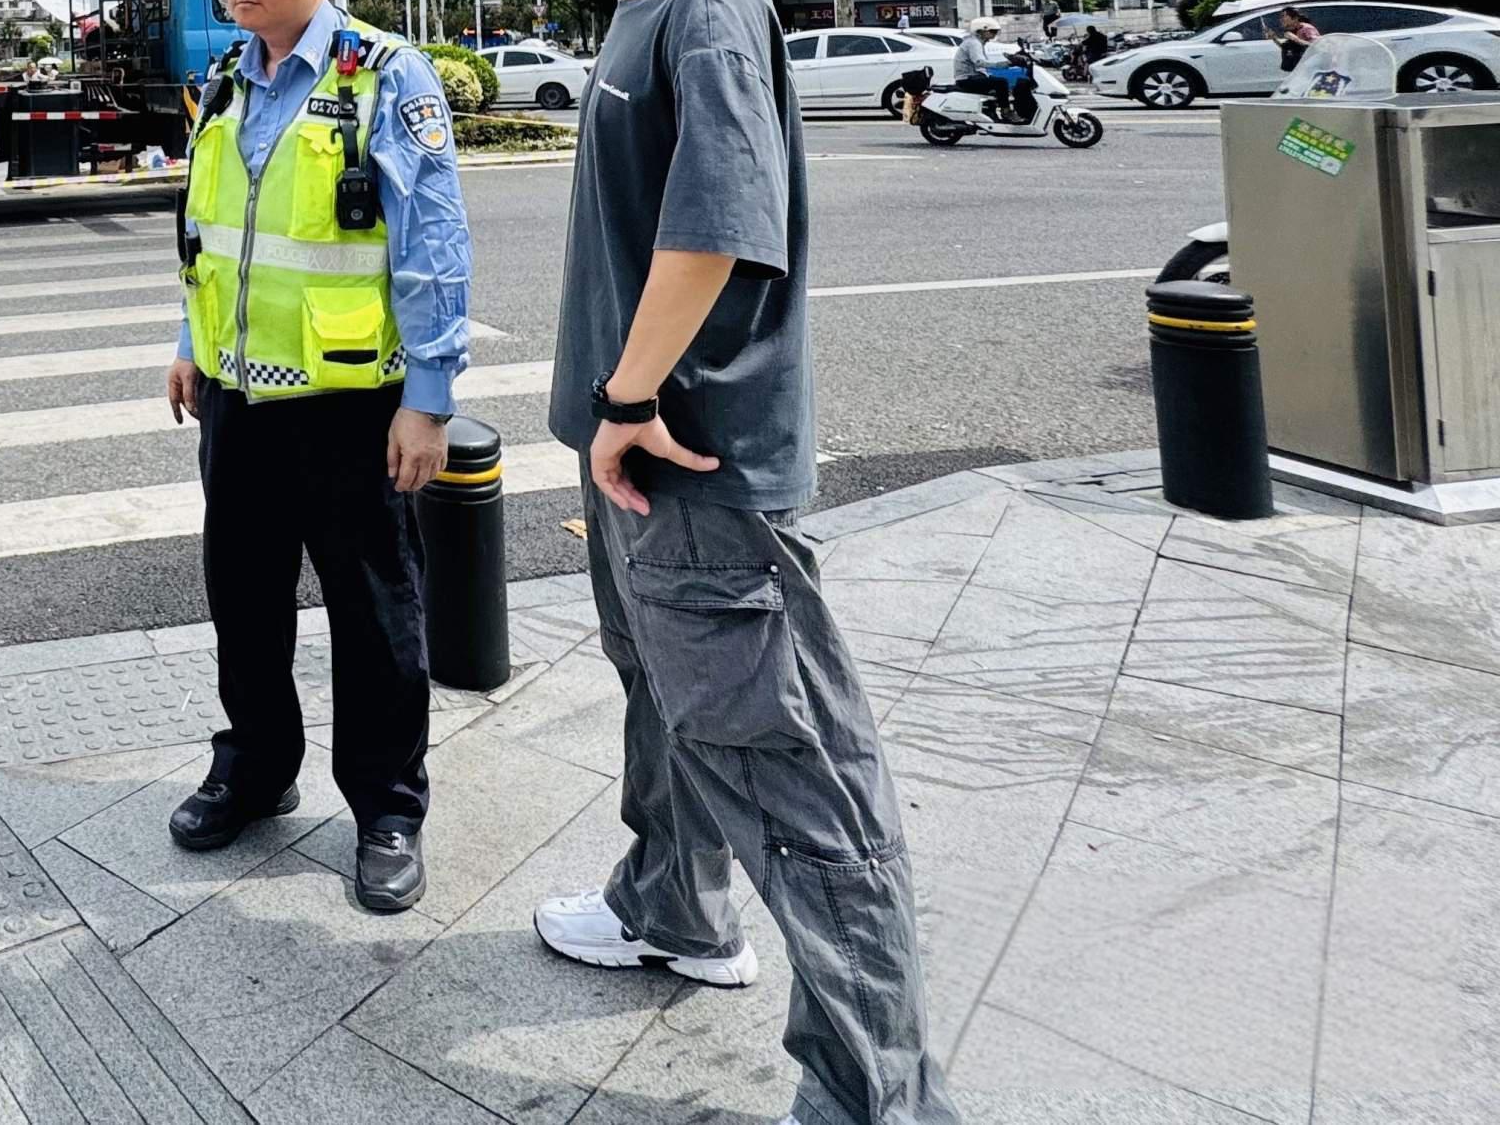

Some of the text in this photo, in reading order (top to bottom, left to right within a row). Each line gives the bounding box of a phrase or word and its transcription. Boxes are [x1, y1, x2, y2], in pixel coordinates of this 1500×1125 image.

[895, 5, 939, 19] 正新鸡
[266, 245, 308, 263] POLICE
